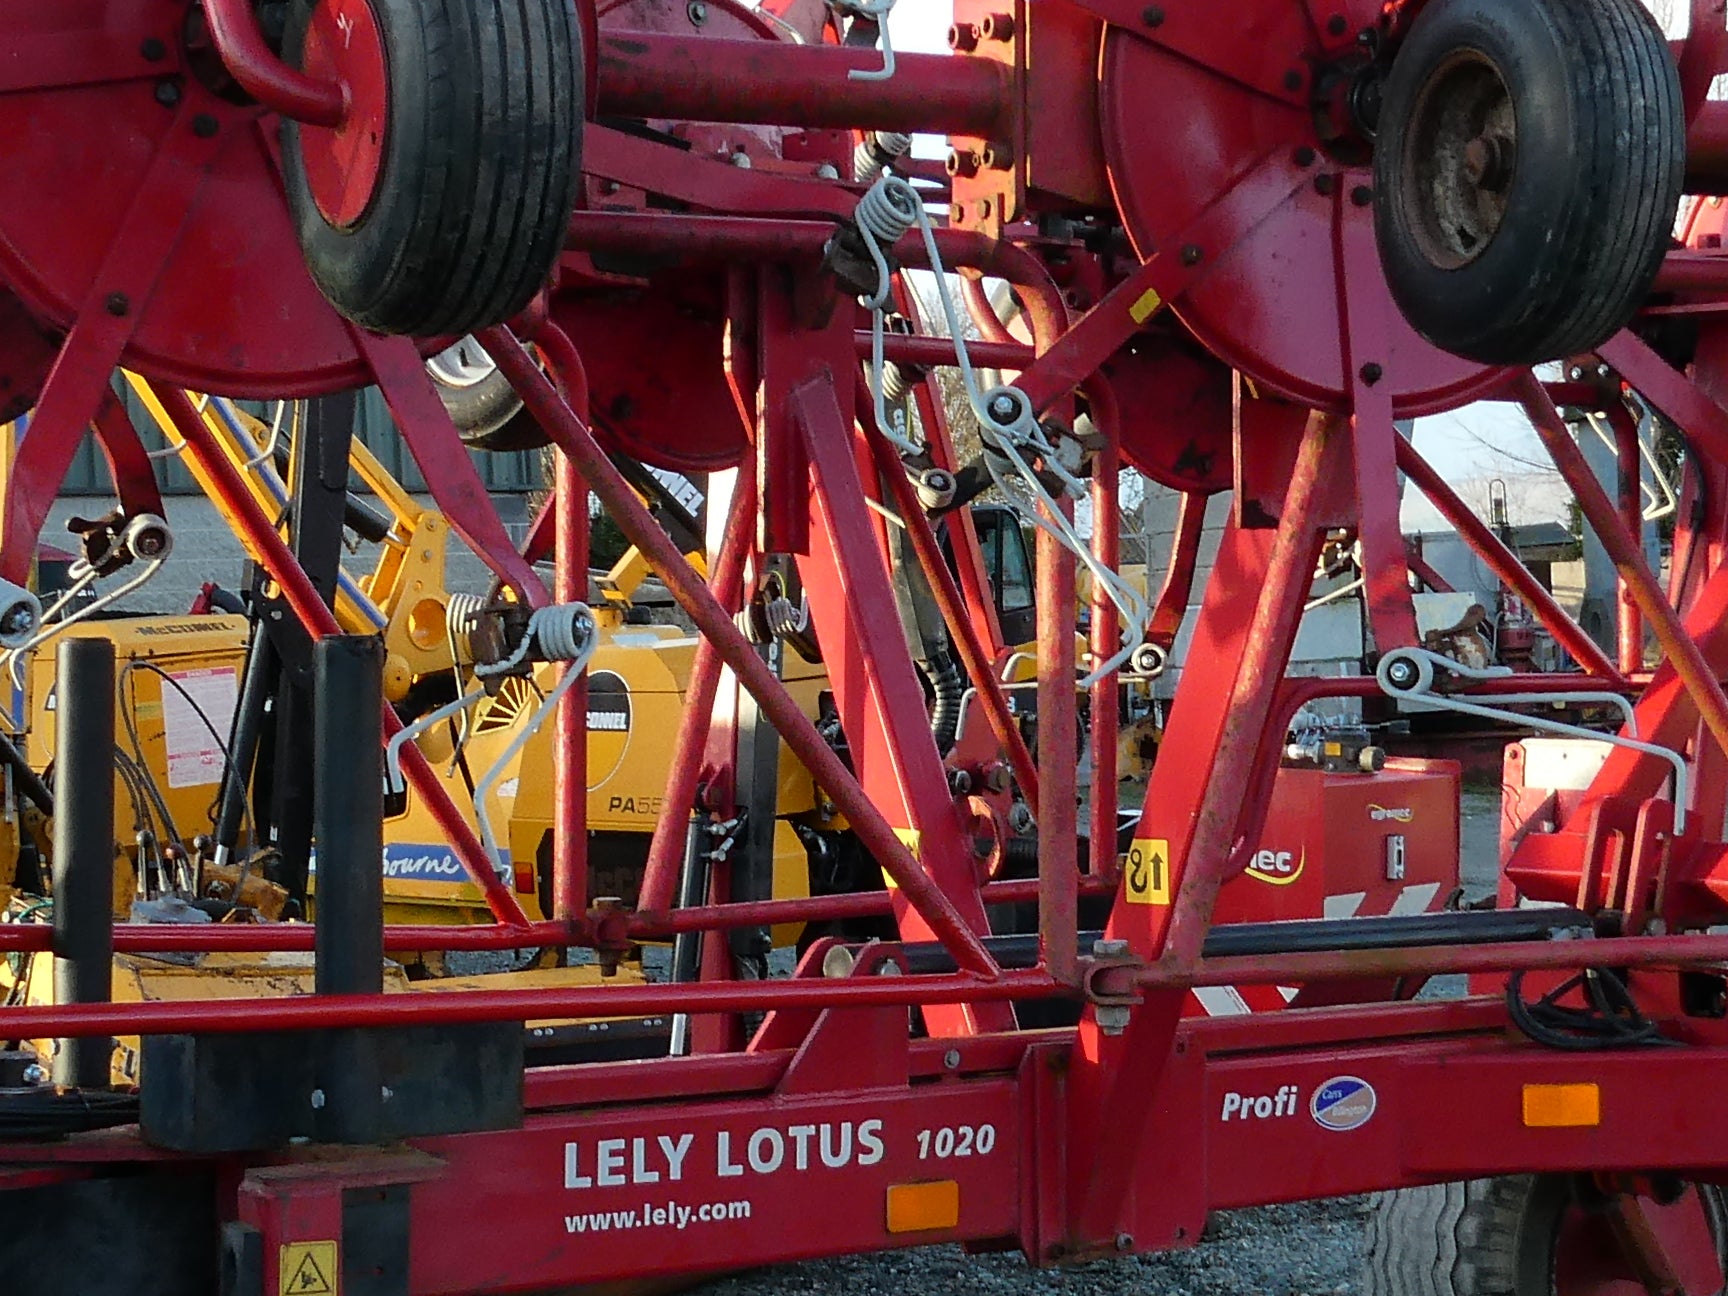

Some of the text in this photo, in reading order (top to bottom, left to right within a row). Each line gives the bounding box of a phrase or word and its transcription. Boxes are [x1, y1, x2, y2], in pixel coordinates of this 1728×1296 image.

[1222, 1085, 1298, 1121] Profi
[565, 1120, 996, 1188] LELY LOTUS 1020
[564, 1198, 751, 1234] www.lely.com
